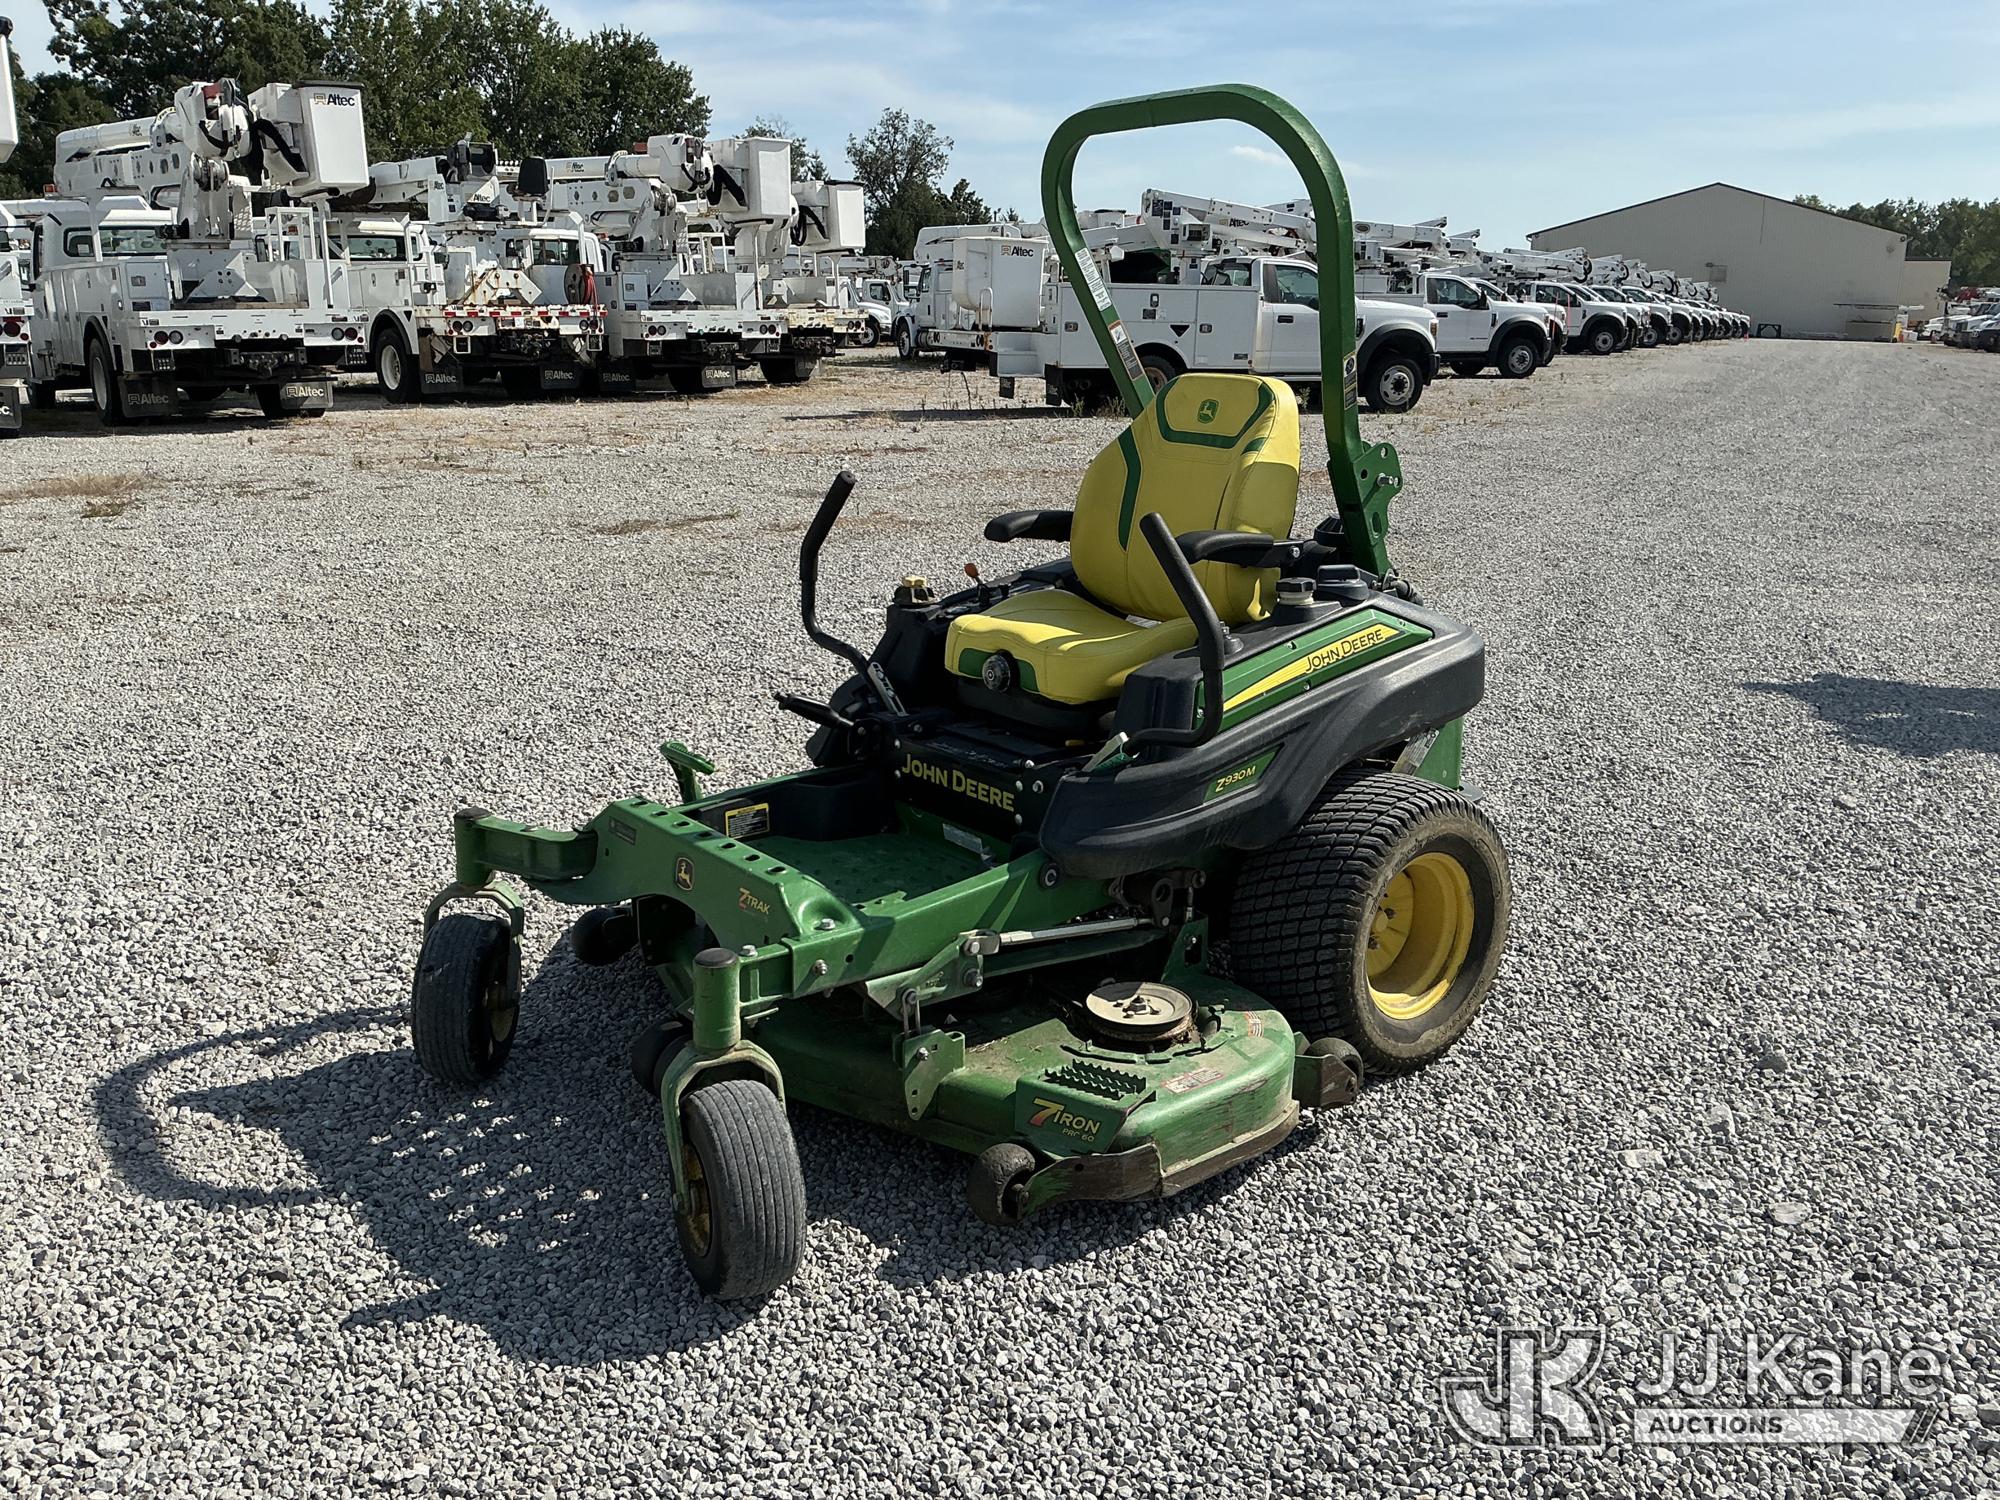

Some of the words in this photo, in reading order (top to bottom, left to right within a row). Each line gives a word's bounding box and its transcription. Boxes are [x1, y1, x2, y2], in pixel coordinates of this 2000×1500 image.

[327, 93, 355, 106] Altec
[1011, 245, 1034, 257] Altec
[435, 373, 457, 383] Altec
[553, 370, 573, 380] Altec
[298, 386, 325, 397] Altec
[141, 393, 169, 405] Altec
[1305, 646, 1341, 673] JOHN
[1341, 629, 1384, 654] DEERE
[901, 753, 949, 788] JOHN
[952, 769, 1015, 813] DEERE
[1215, 765, 1256, 793] Z930M
